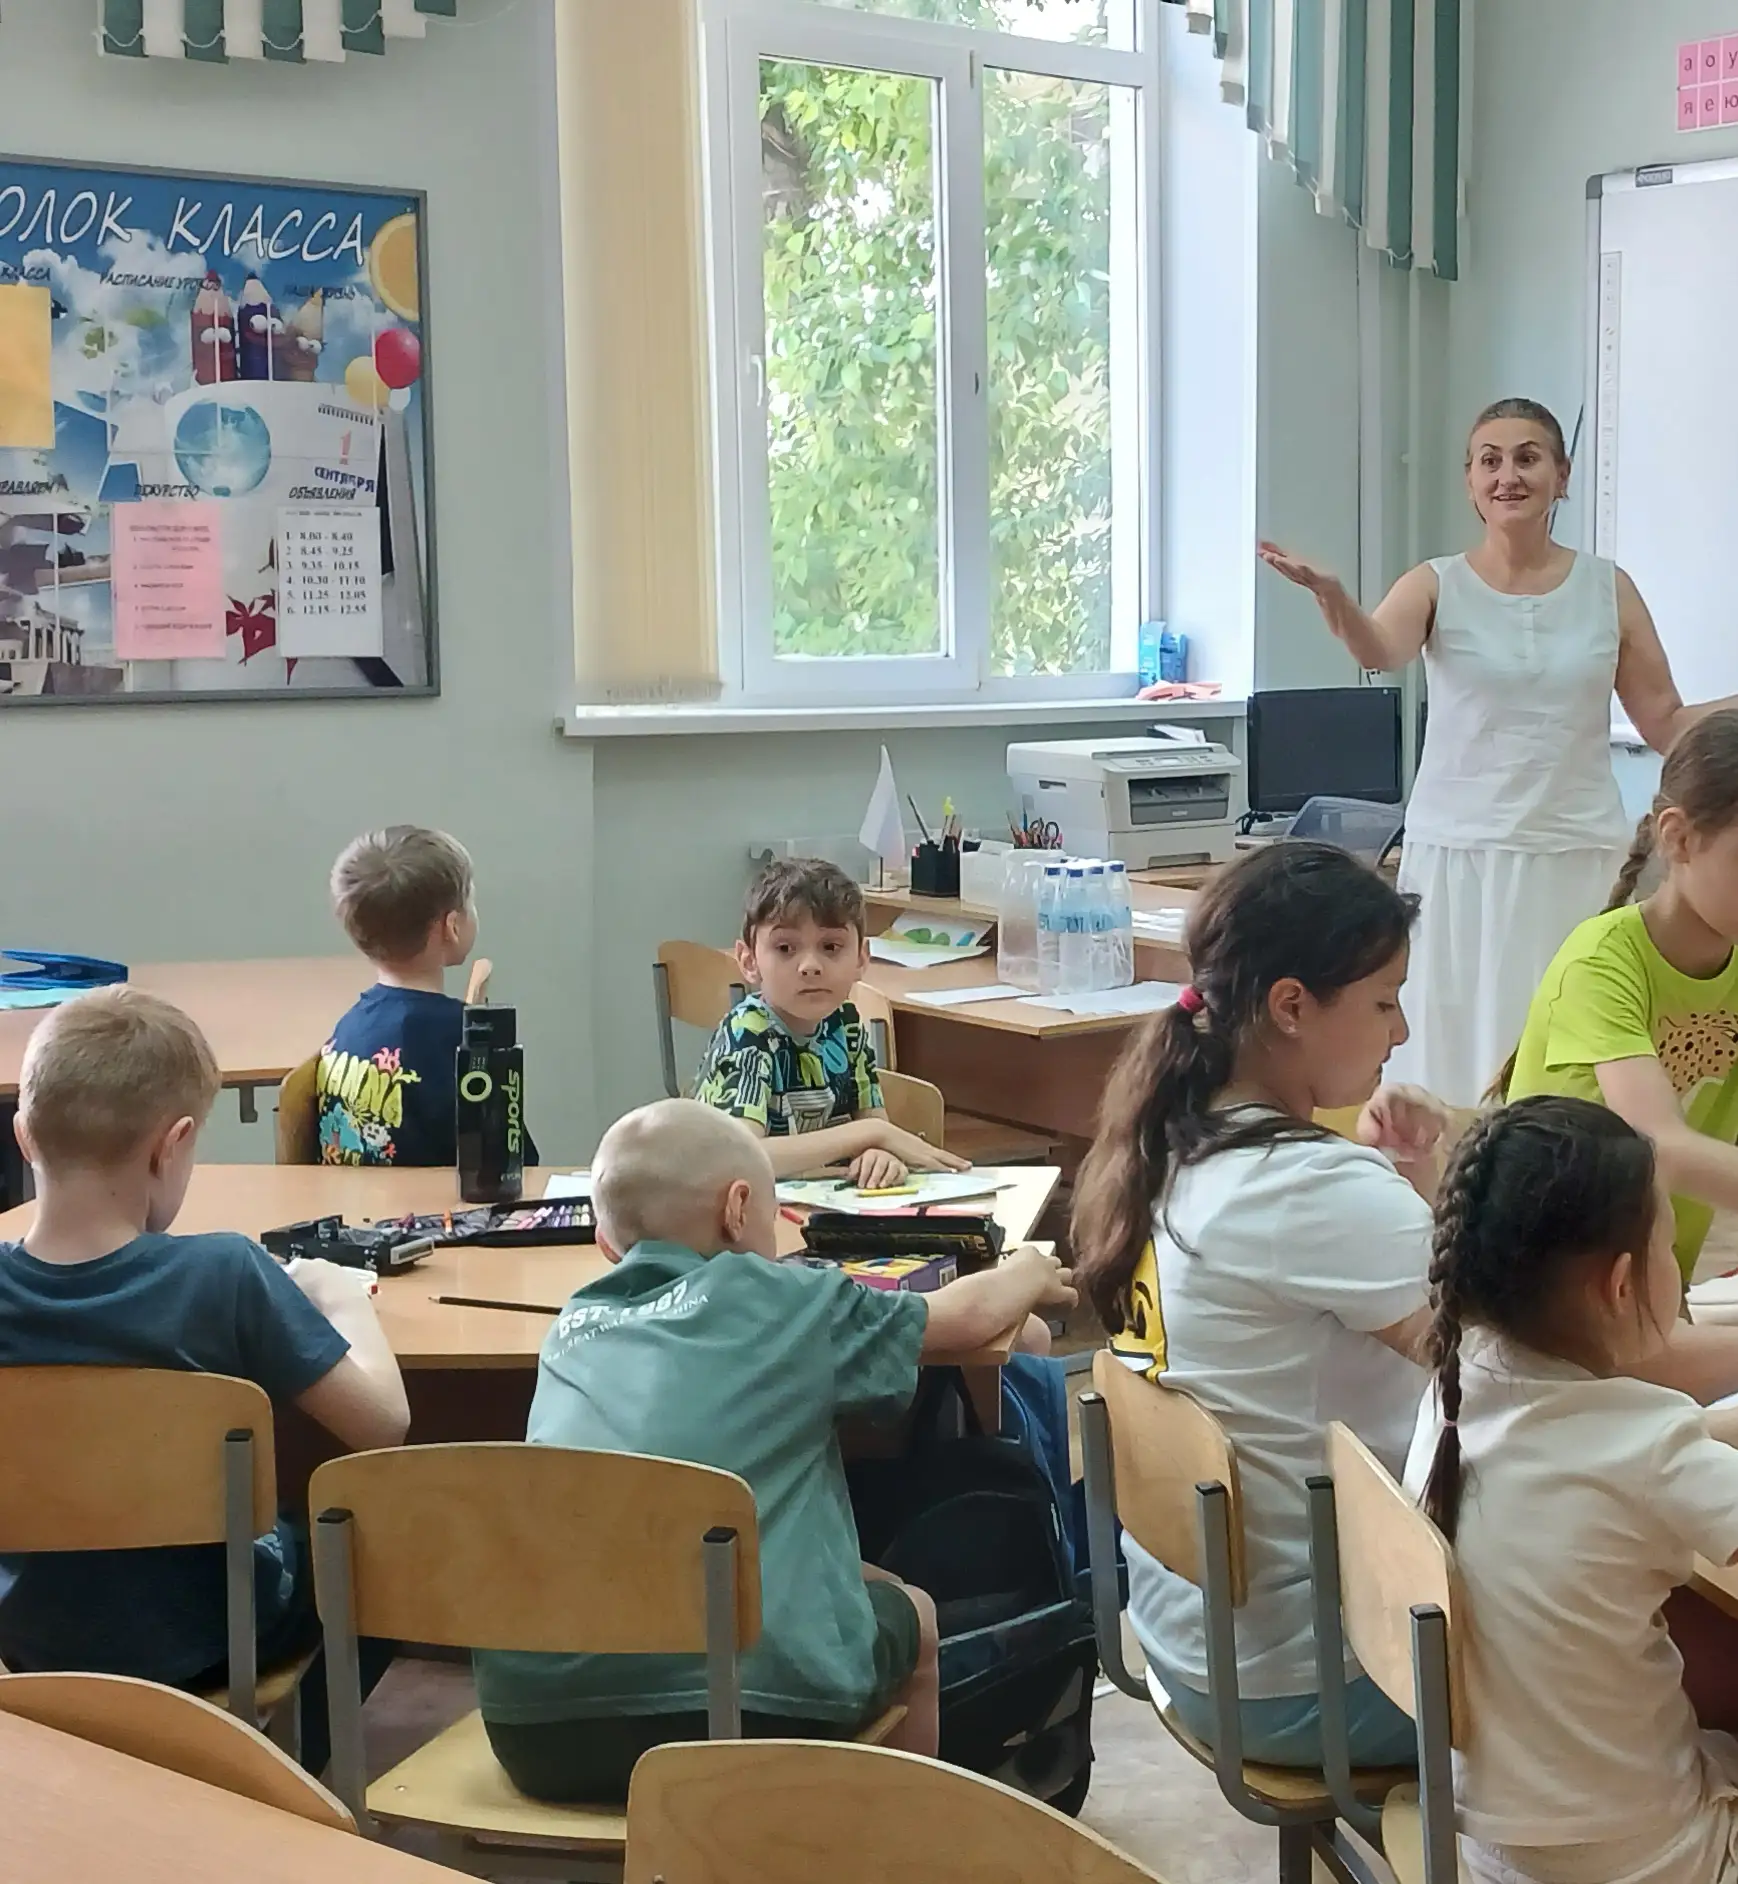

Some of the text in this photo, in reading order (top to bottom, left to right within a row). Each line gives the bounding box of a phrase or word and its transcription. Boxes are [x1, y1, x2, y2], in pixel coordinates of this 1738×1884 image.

[1684, 50, 1738, 71] а о у
[1684, 94, 1738, 115] я е ю
[166, 196, 365, 268] КЛАССА
[500, 1069, 521, 1154] sports
